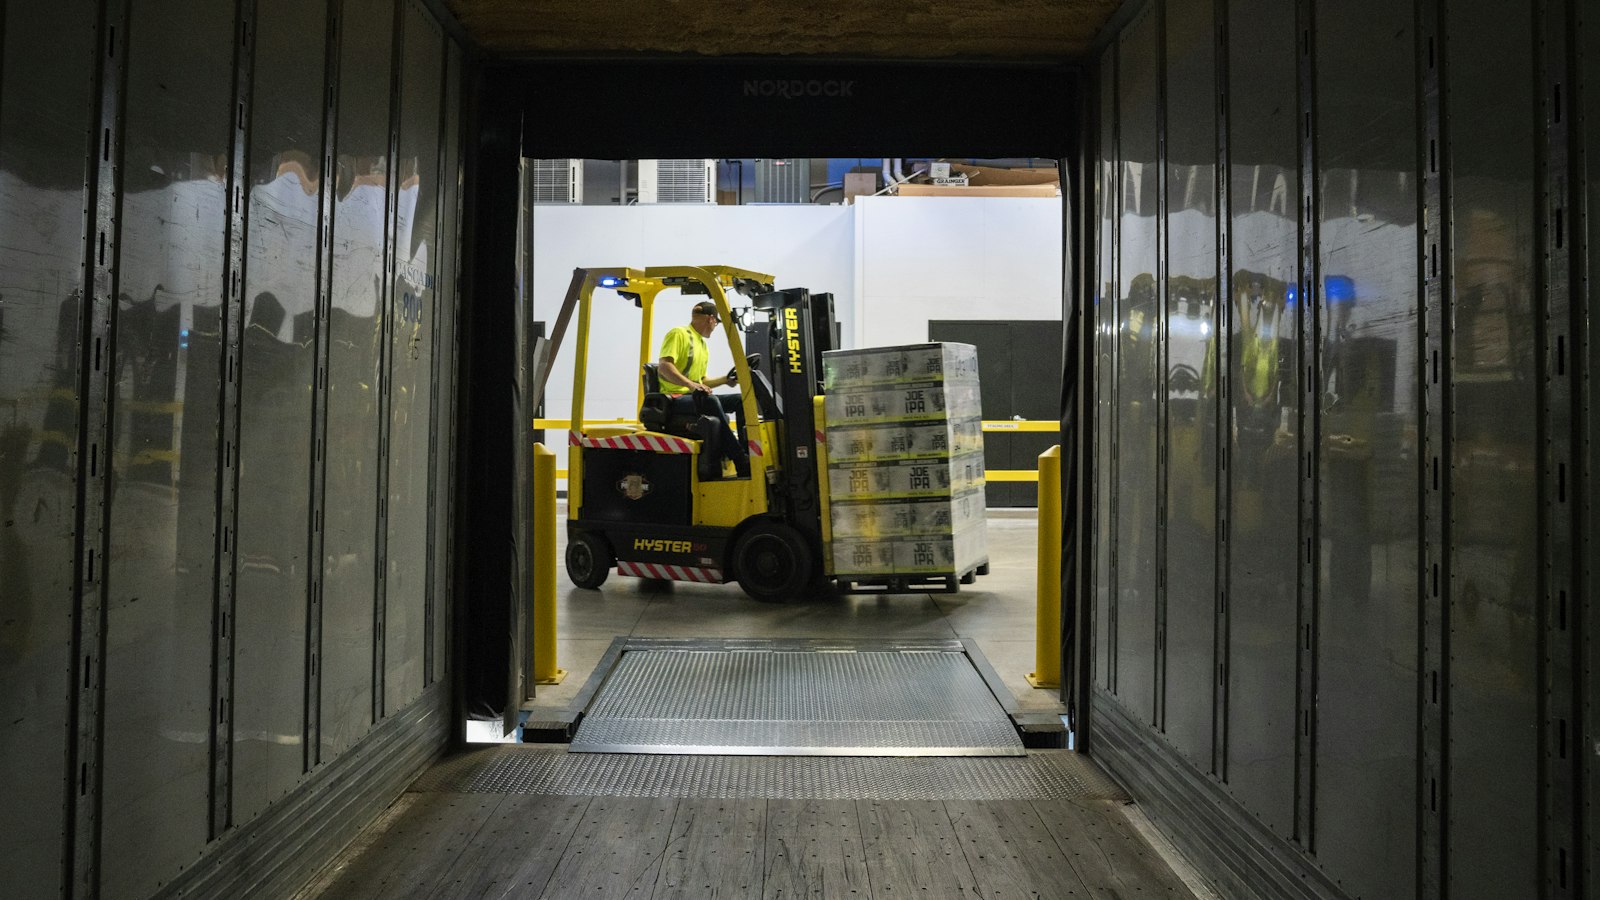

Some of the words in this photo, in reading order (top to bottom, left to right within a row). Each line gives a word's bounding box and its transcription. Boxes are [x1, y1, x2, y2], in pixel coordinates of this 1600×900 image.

[743, 80, 855, 99] NORDOCK
[403, 292, 422, 323] 800
[785, 308, 801, 373] HYSTER
[886, 367, 900, 376] IPA
[926, 364, 941, 373] IPA
[845, 395, 864, 405] JOE
[905, 391, 924, 401] JOE
[845, 405, 865, 417] IPA
[905, 401, 925, 413] IPA
[891, 443, 906, 451] IPA
[931, 442, 946, 450] IPA
[849, 470, 868, 479] JOE
[909, 467, 928, 476] JOE
[850, 480, 869, 493] IPA
[910, 477, 930, 489] IPA
[634, 539, 692, 553] HYSTER
[853, 545, 872, 555] JOE
[914, 543, 934, 553] JOE
[853, 555, 872, 567] IPA
[914, 553, 934, 565] IPA
